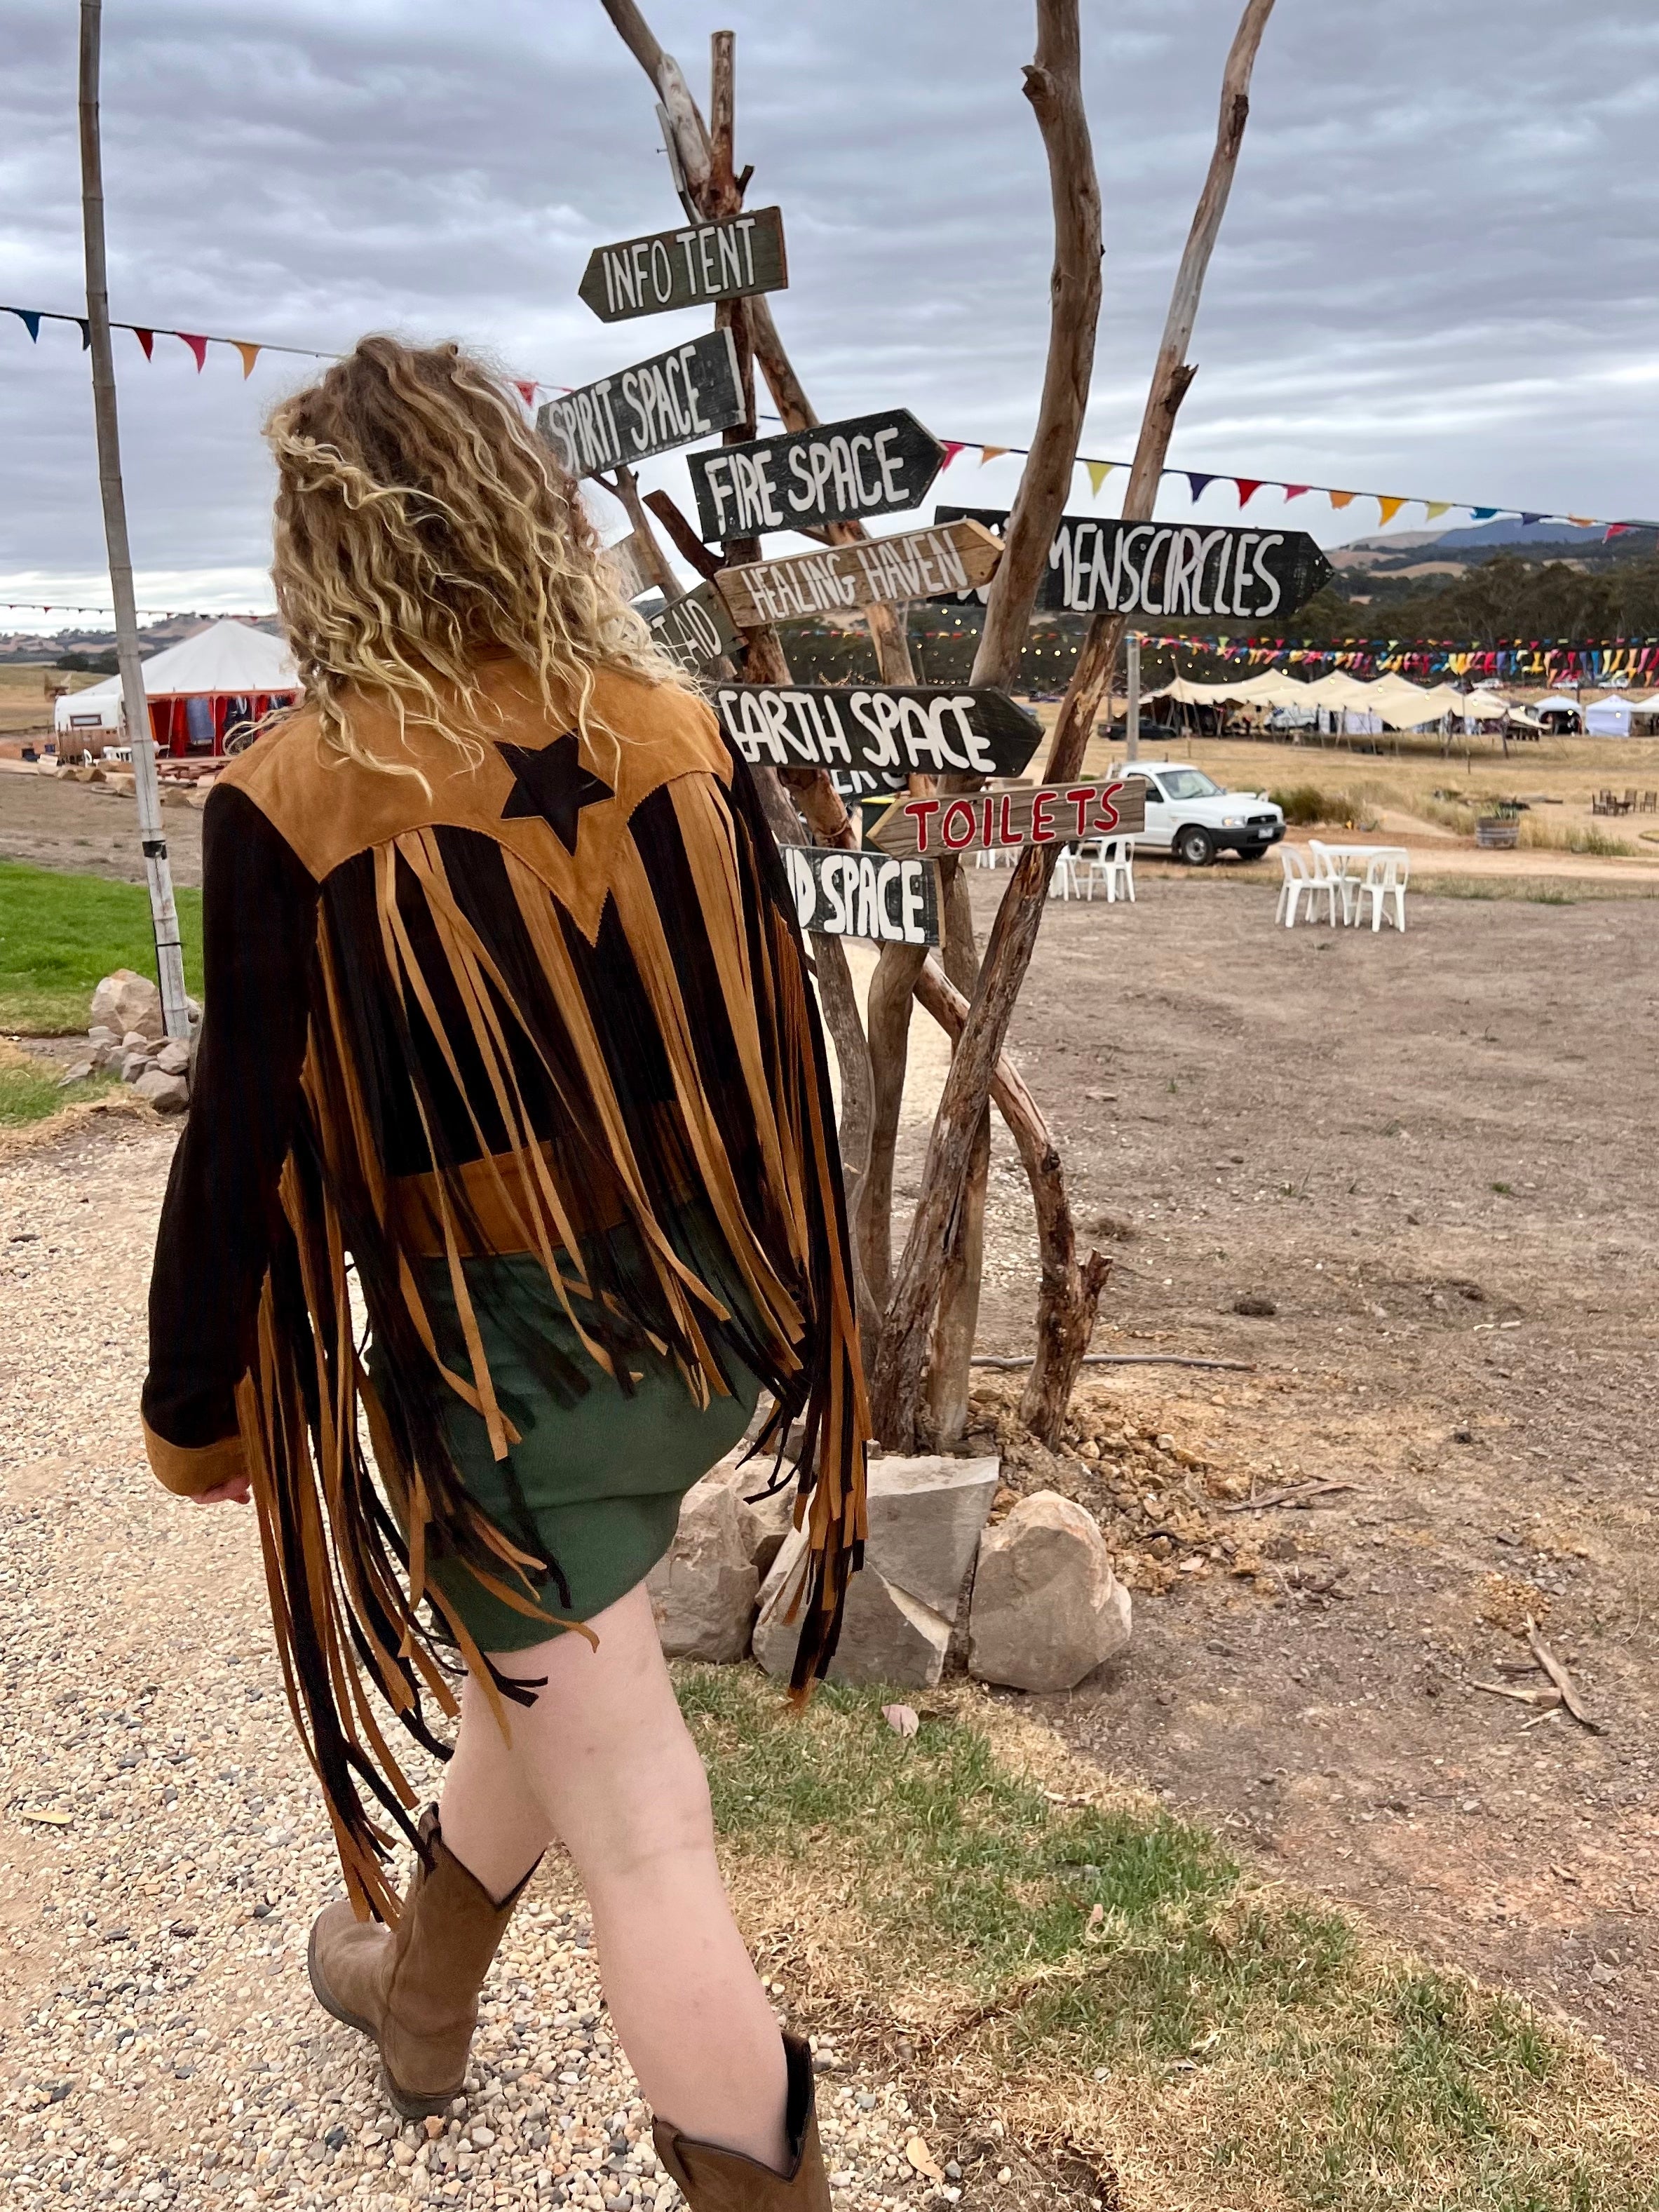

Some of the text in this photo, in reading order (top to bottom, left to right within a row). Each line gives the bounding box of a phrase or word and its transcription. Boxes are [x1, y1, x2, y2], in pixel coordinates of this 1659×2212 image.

[602, 218, 756, 313] INFO TENT
[549, 344, 711, 474] SPIRIT SPACE
[704, 426, 910, 536] FIRE SPACE
[740, 530, 968, 622] HEALING HAVEN
[671, 598, 722, 661] AID
[718, 689, 997, 773] EARTH SPACE
[903, 782, 1125, 854] TOILETS
[820, 854, 926, 944] SPACE
